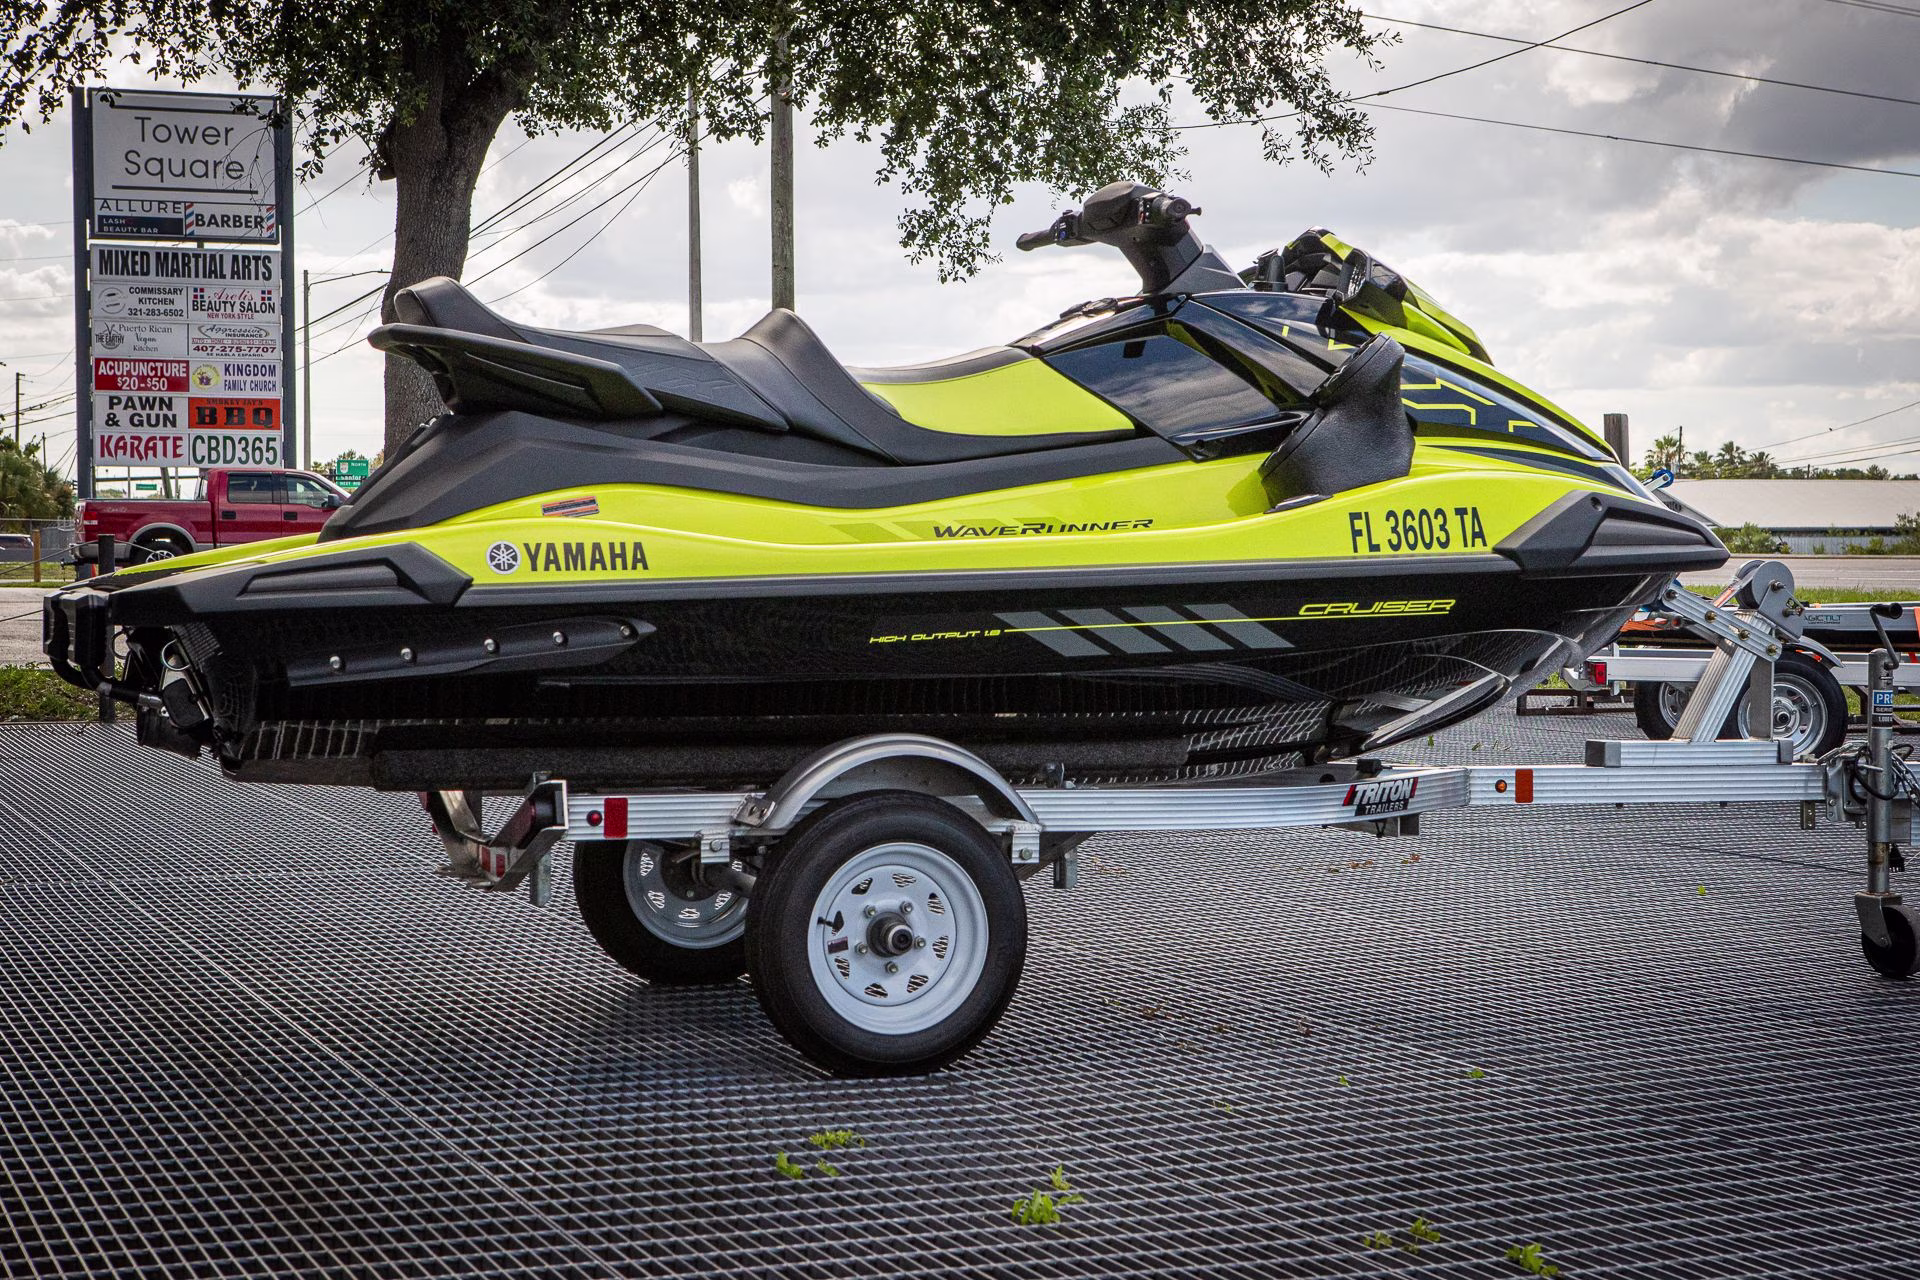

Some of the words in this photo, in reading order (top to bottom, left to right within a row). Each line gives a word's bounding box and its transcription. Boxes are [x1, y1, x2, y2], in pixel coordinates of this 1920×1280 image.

[134, 116, 235, 146] Tower
[124, 150, 244, 183] Square
[100, 200, 182, 214] ALLURE
[195, 214, 264, 229] BARBER
[98, 249, 150, 276] MIXED
[155, 251, 226, 280] MARTIAL
[230, 254, 272, 281] ARTS
[128, 287, 184, 295] COMMISSARY
[128, 308, 184, 317] 321-283-6502
[192, 300, 236, 312] BEAUTY
[239, 302, 275, 314] SALON
[119, 324, 146, 332] Puerto
[149, 325, 172, 333] Rican
[98, 361, 187, 377] ACUPUNCTURE
[224, 364, 276, 377] KINGDOM
[224, 380, 247, 391] FAMILY
[250, 380, 276, 392] CHURCH
[108, 396, 173, 411] PAWN
[105, 412, 120, 427] &
[129, 413, 177, 428] GUN
[196, 406, 272, 428] BBQ
[100, 435, 184, 461] KARATE
[192, 435, 278, 465] CBD365
[1348, 512, 1381, 553] FL
[1385, 508, 1450, 552] 3603
[1454, 506, 1488, 548] TA
[523, 542, 649, 572] YAMAHA
[1299, 599, 1456, 615] CRUISER
[869, 635, 907, 644] HIGH
[911, 630, 980, 641] OUTPUT
[1353, 778, 1414, 805] TRITON
[1365, 802, 1404, 814] TRAILERS
